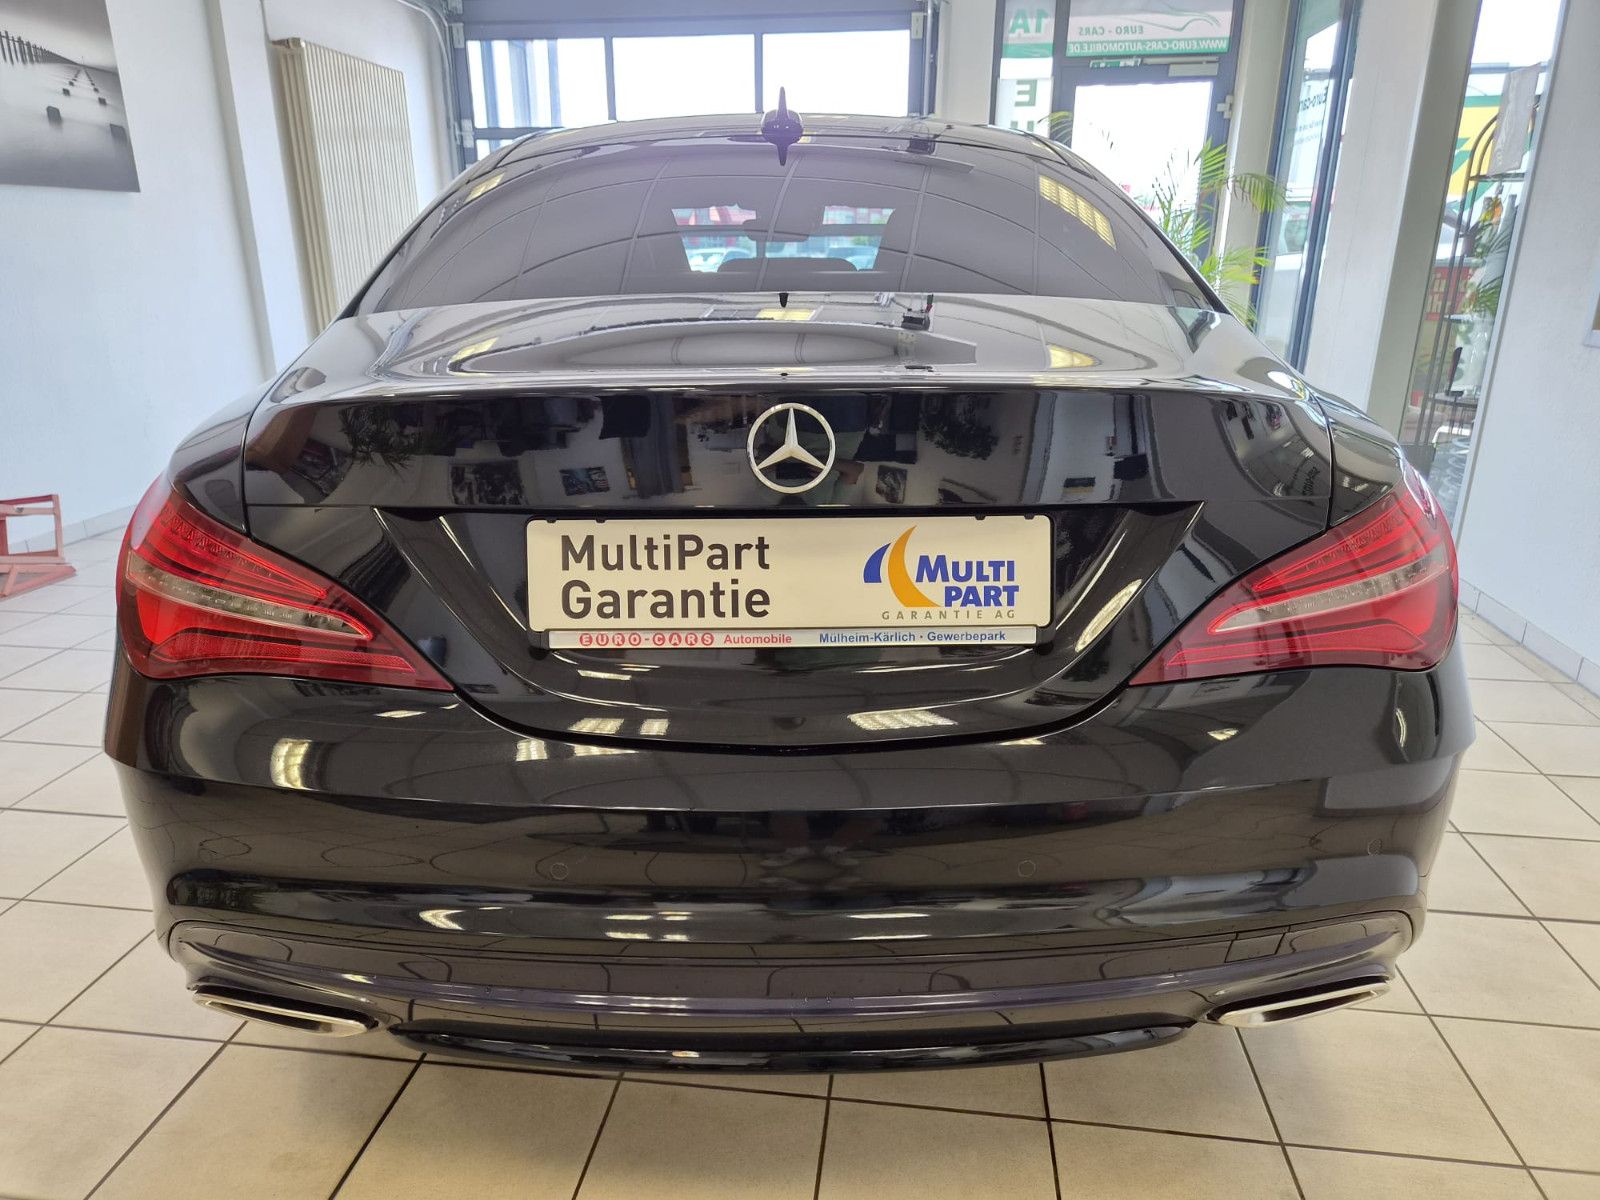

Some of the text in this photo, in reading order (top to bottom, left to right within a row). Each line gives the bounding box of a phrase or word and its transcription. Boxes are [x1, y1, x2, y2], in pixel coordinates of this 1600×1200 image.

[561, 534, 770, 571] MultiPart
[915, 554, 1015, 583] MULTI
[561, 578, 771, 620] Garantie
[944, 585, 1020, 608] PART
[881, 609, 1015, 620] GARANTIE AG
[579, 631, 1006, 647] EURO-CARS Automobile Mülheim-Kärlich Gewerbepark
